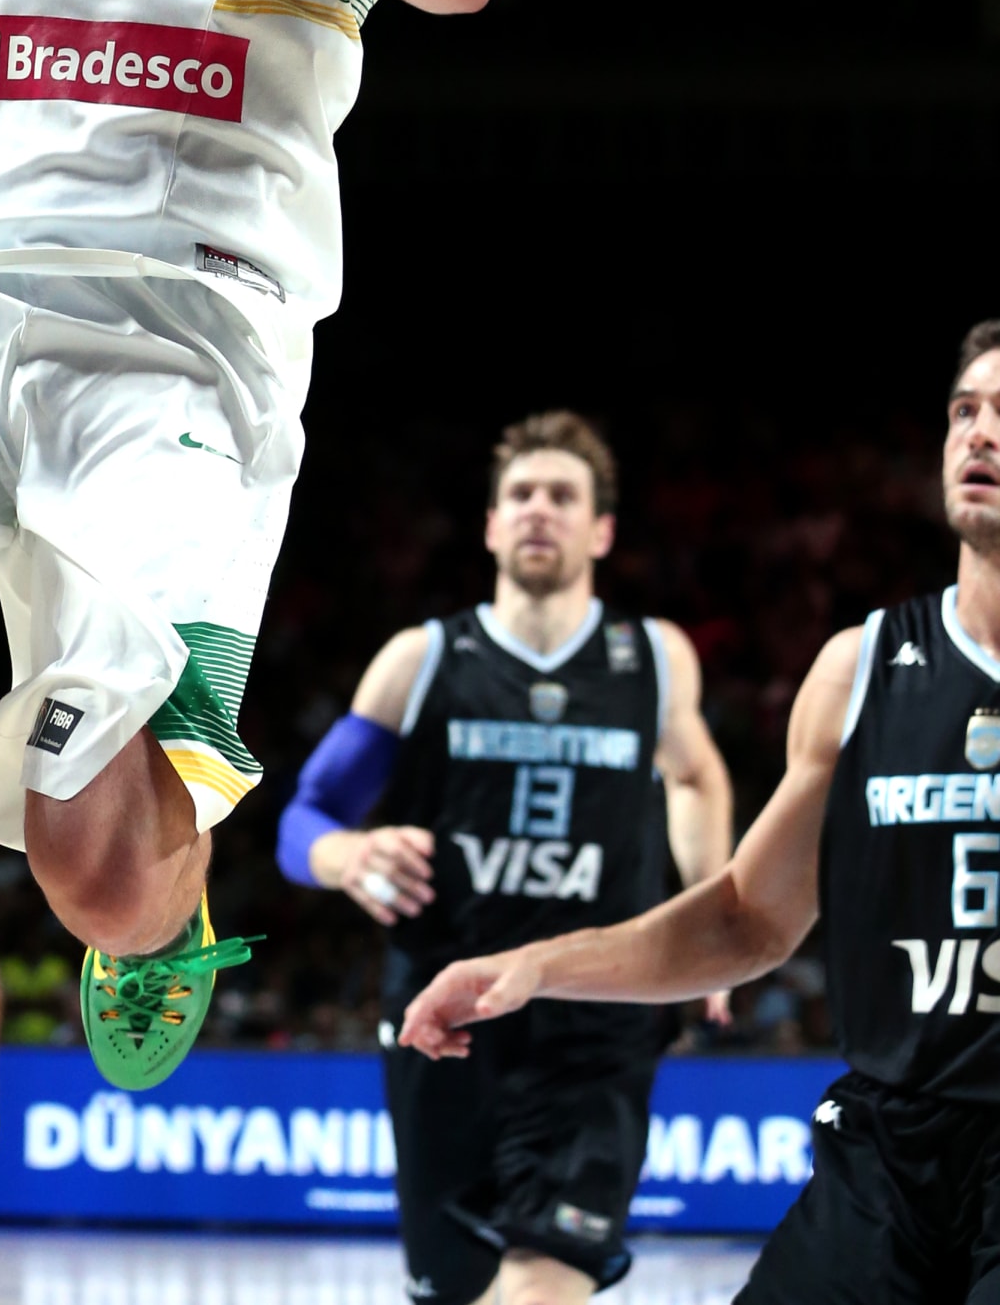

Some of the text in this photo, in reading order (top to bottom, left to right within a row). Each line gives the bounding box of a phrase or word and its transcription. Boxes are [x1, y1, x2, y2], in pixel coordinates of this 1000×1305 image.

[6, 34, 234, 99] Bradesco
[49, 708, 75, 730] FIBA
[509, 764, 576, 840] 13
[450, 831, 604, 903] VISA
[952, 831, 1000, 929] 6
